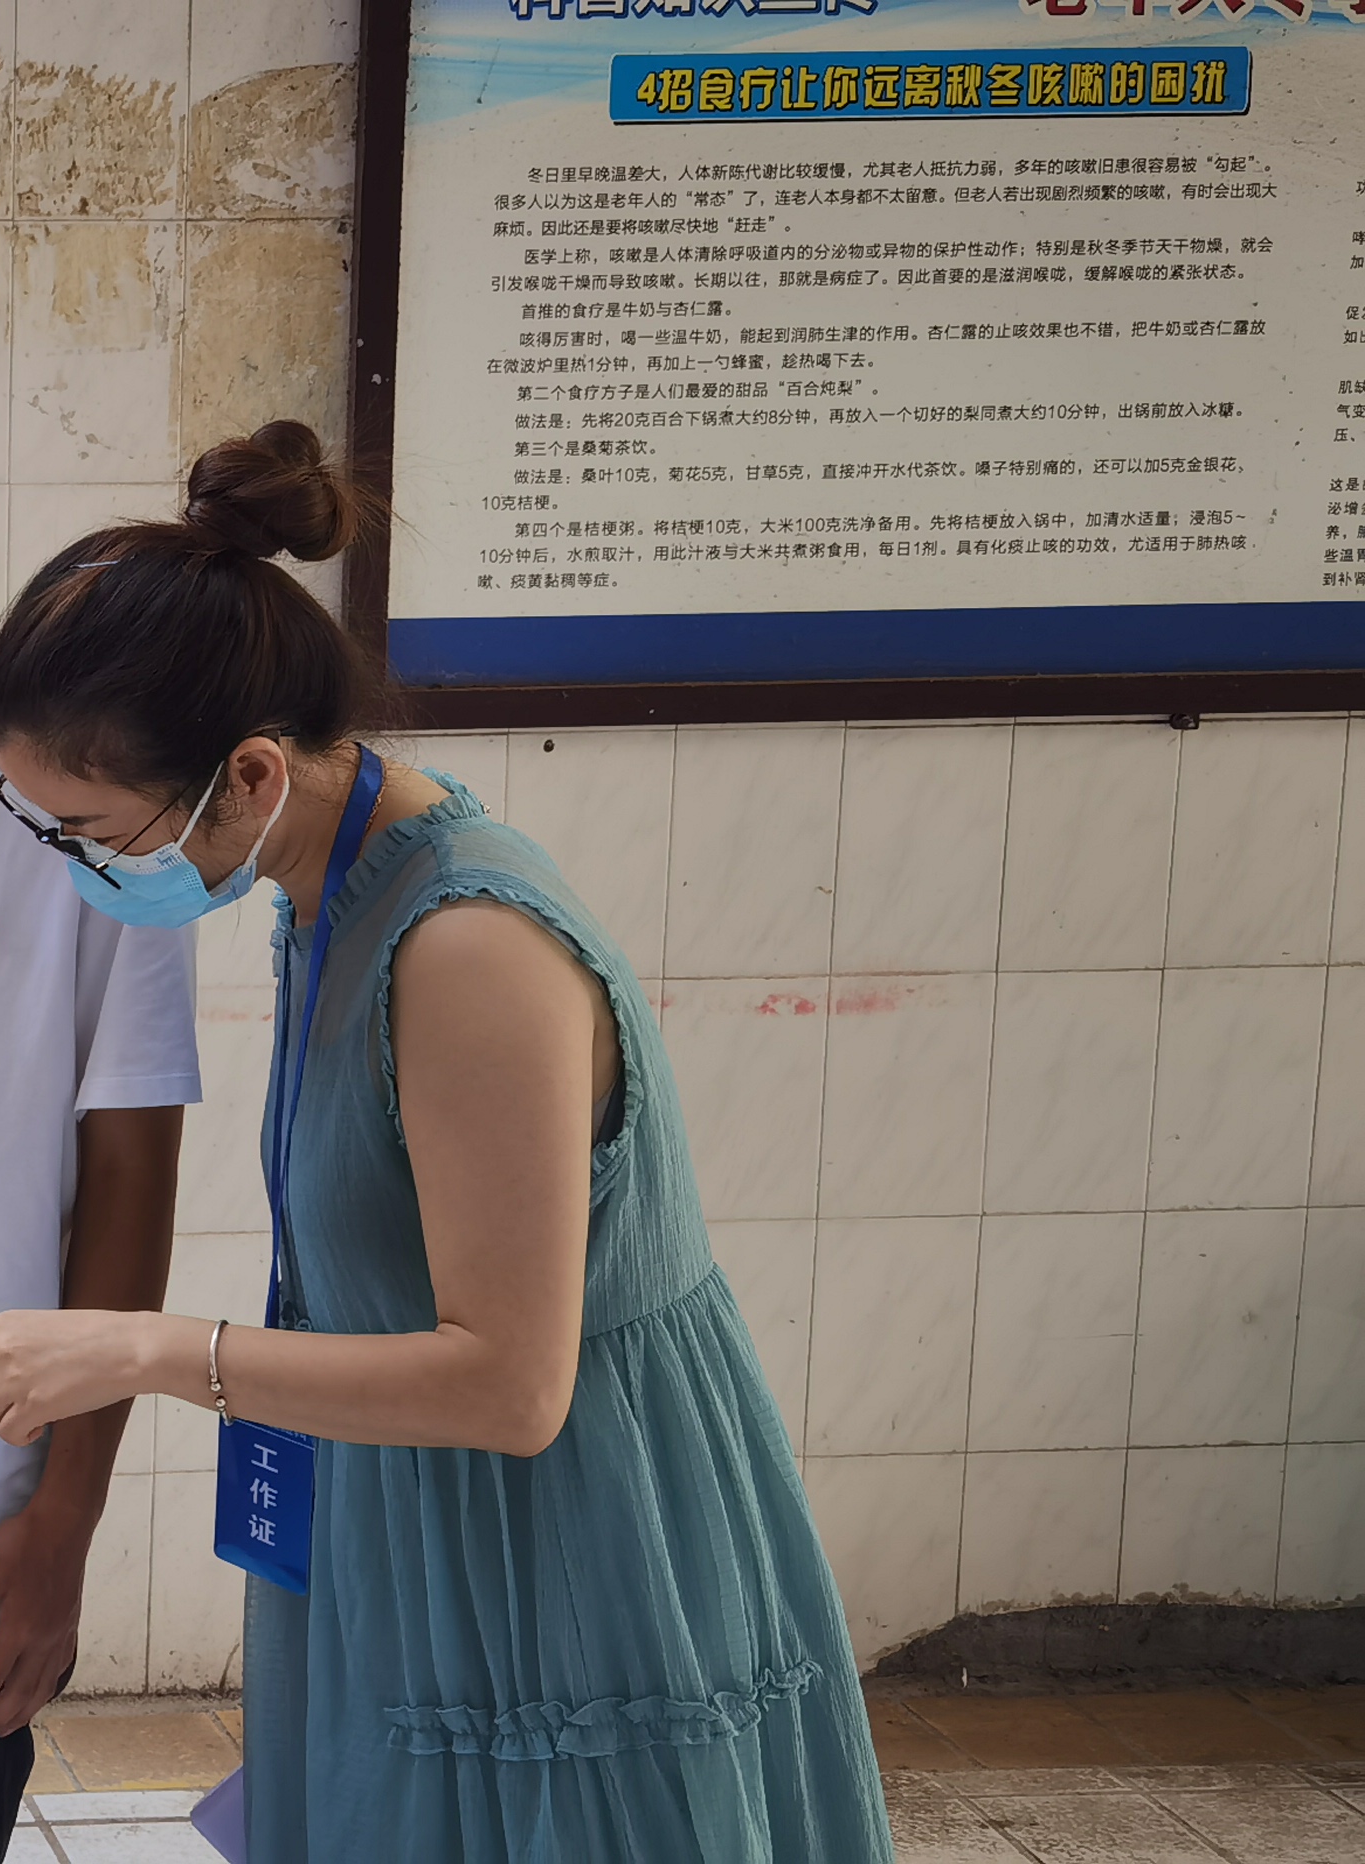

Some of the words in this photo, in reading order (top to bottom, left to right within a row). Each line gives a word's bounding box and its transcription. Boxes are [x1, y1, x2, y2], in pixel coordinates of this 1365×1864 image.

[636, 61, 1229, 113] 4招食疗让你远离秋冬咳嗽的困扰
[521, 300, 734, 319] 首推的食疗是牛奶与杏仁露。
[514, 440, 659, 458] 第三个是桑菊茶饮。
[482, 495, 559, 511] 10克桔梗。
[249, 1442, 280, 1547] 工作证
